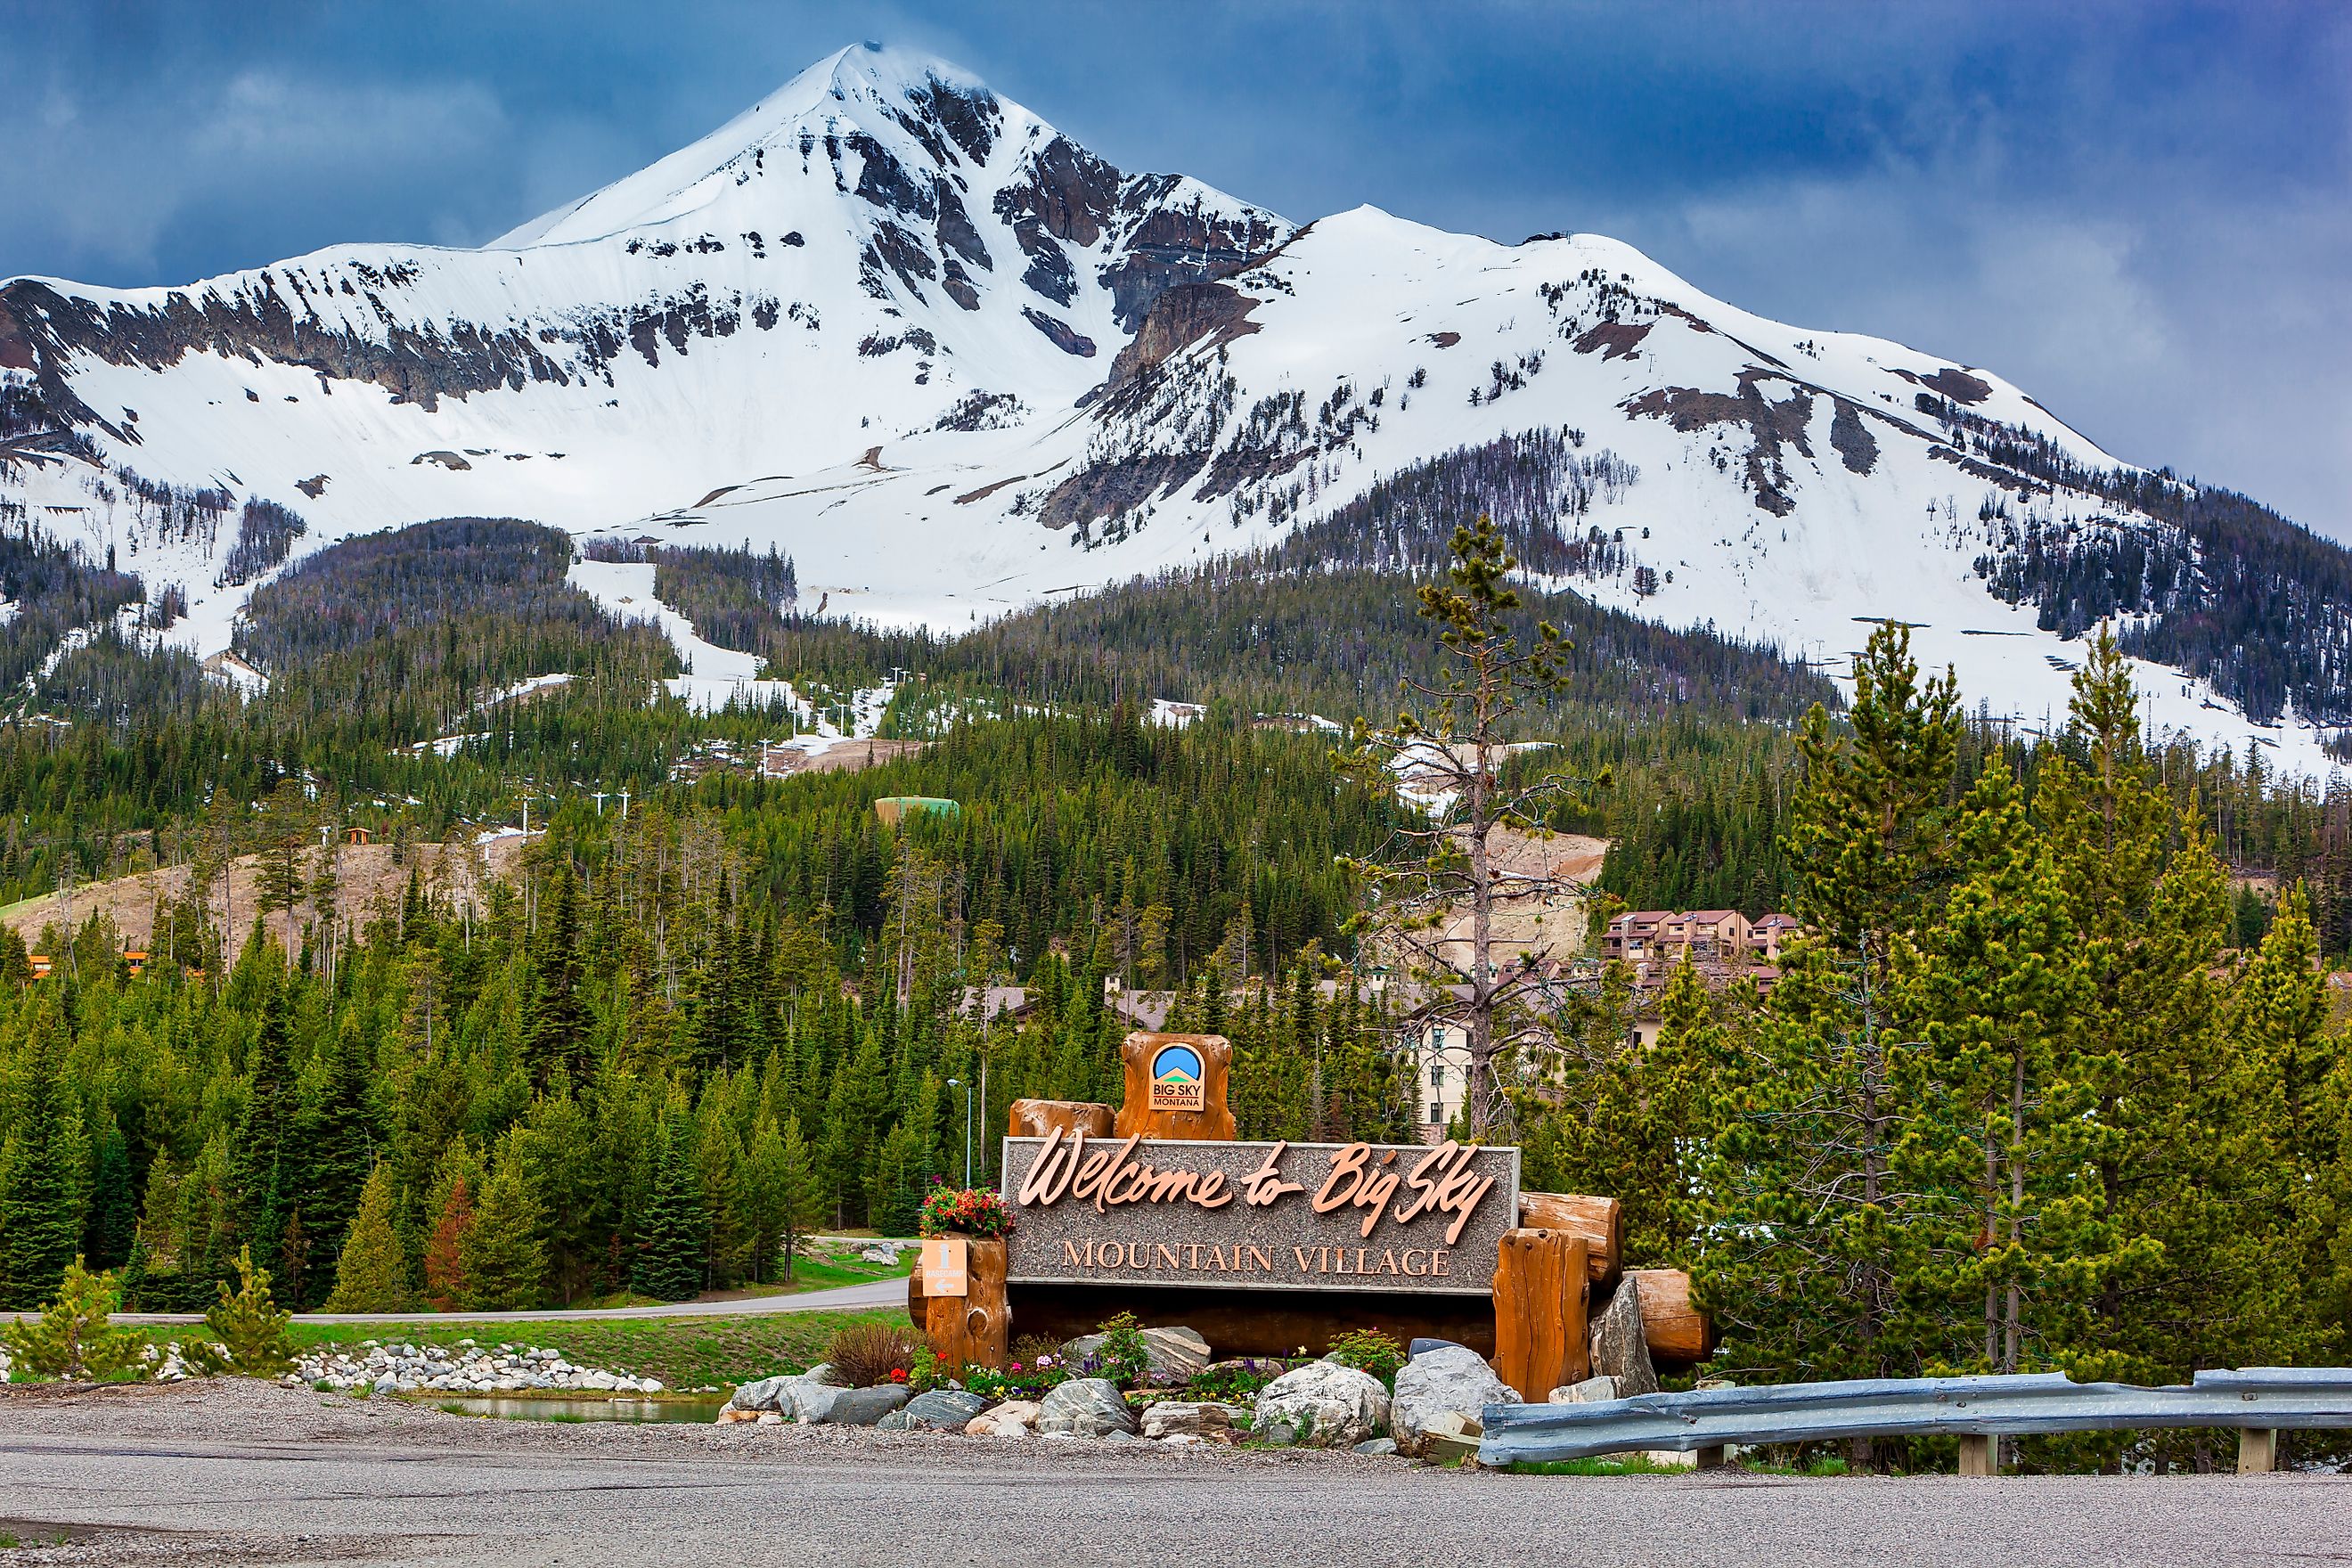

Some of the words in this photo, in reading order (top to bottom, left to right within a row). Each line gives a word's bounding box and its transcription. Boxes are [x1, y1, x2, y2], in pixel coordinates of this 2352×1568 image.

[1154, 1084, 1175, 1096] BIG
[1178, 1084, 1201, 1096] SKY
[1154, 1098, 1199, 1107] MONTANA
[1018, 1125, 1233, 1213] Welcome
[1240, 1139, 1305, 1205] to
[1311, 1142, 1401, 1238] Big
[1394, 1139, 1495, 1245] Sky
[1063, 1240, 1273, 1273] MOUNTAIN
[1293, 1245, 1450, 1277] VILLAGE
[927, 1270, 964, 1278] BASECAMP
